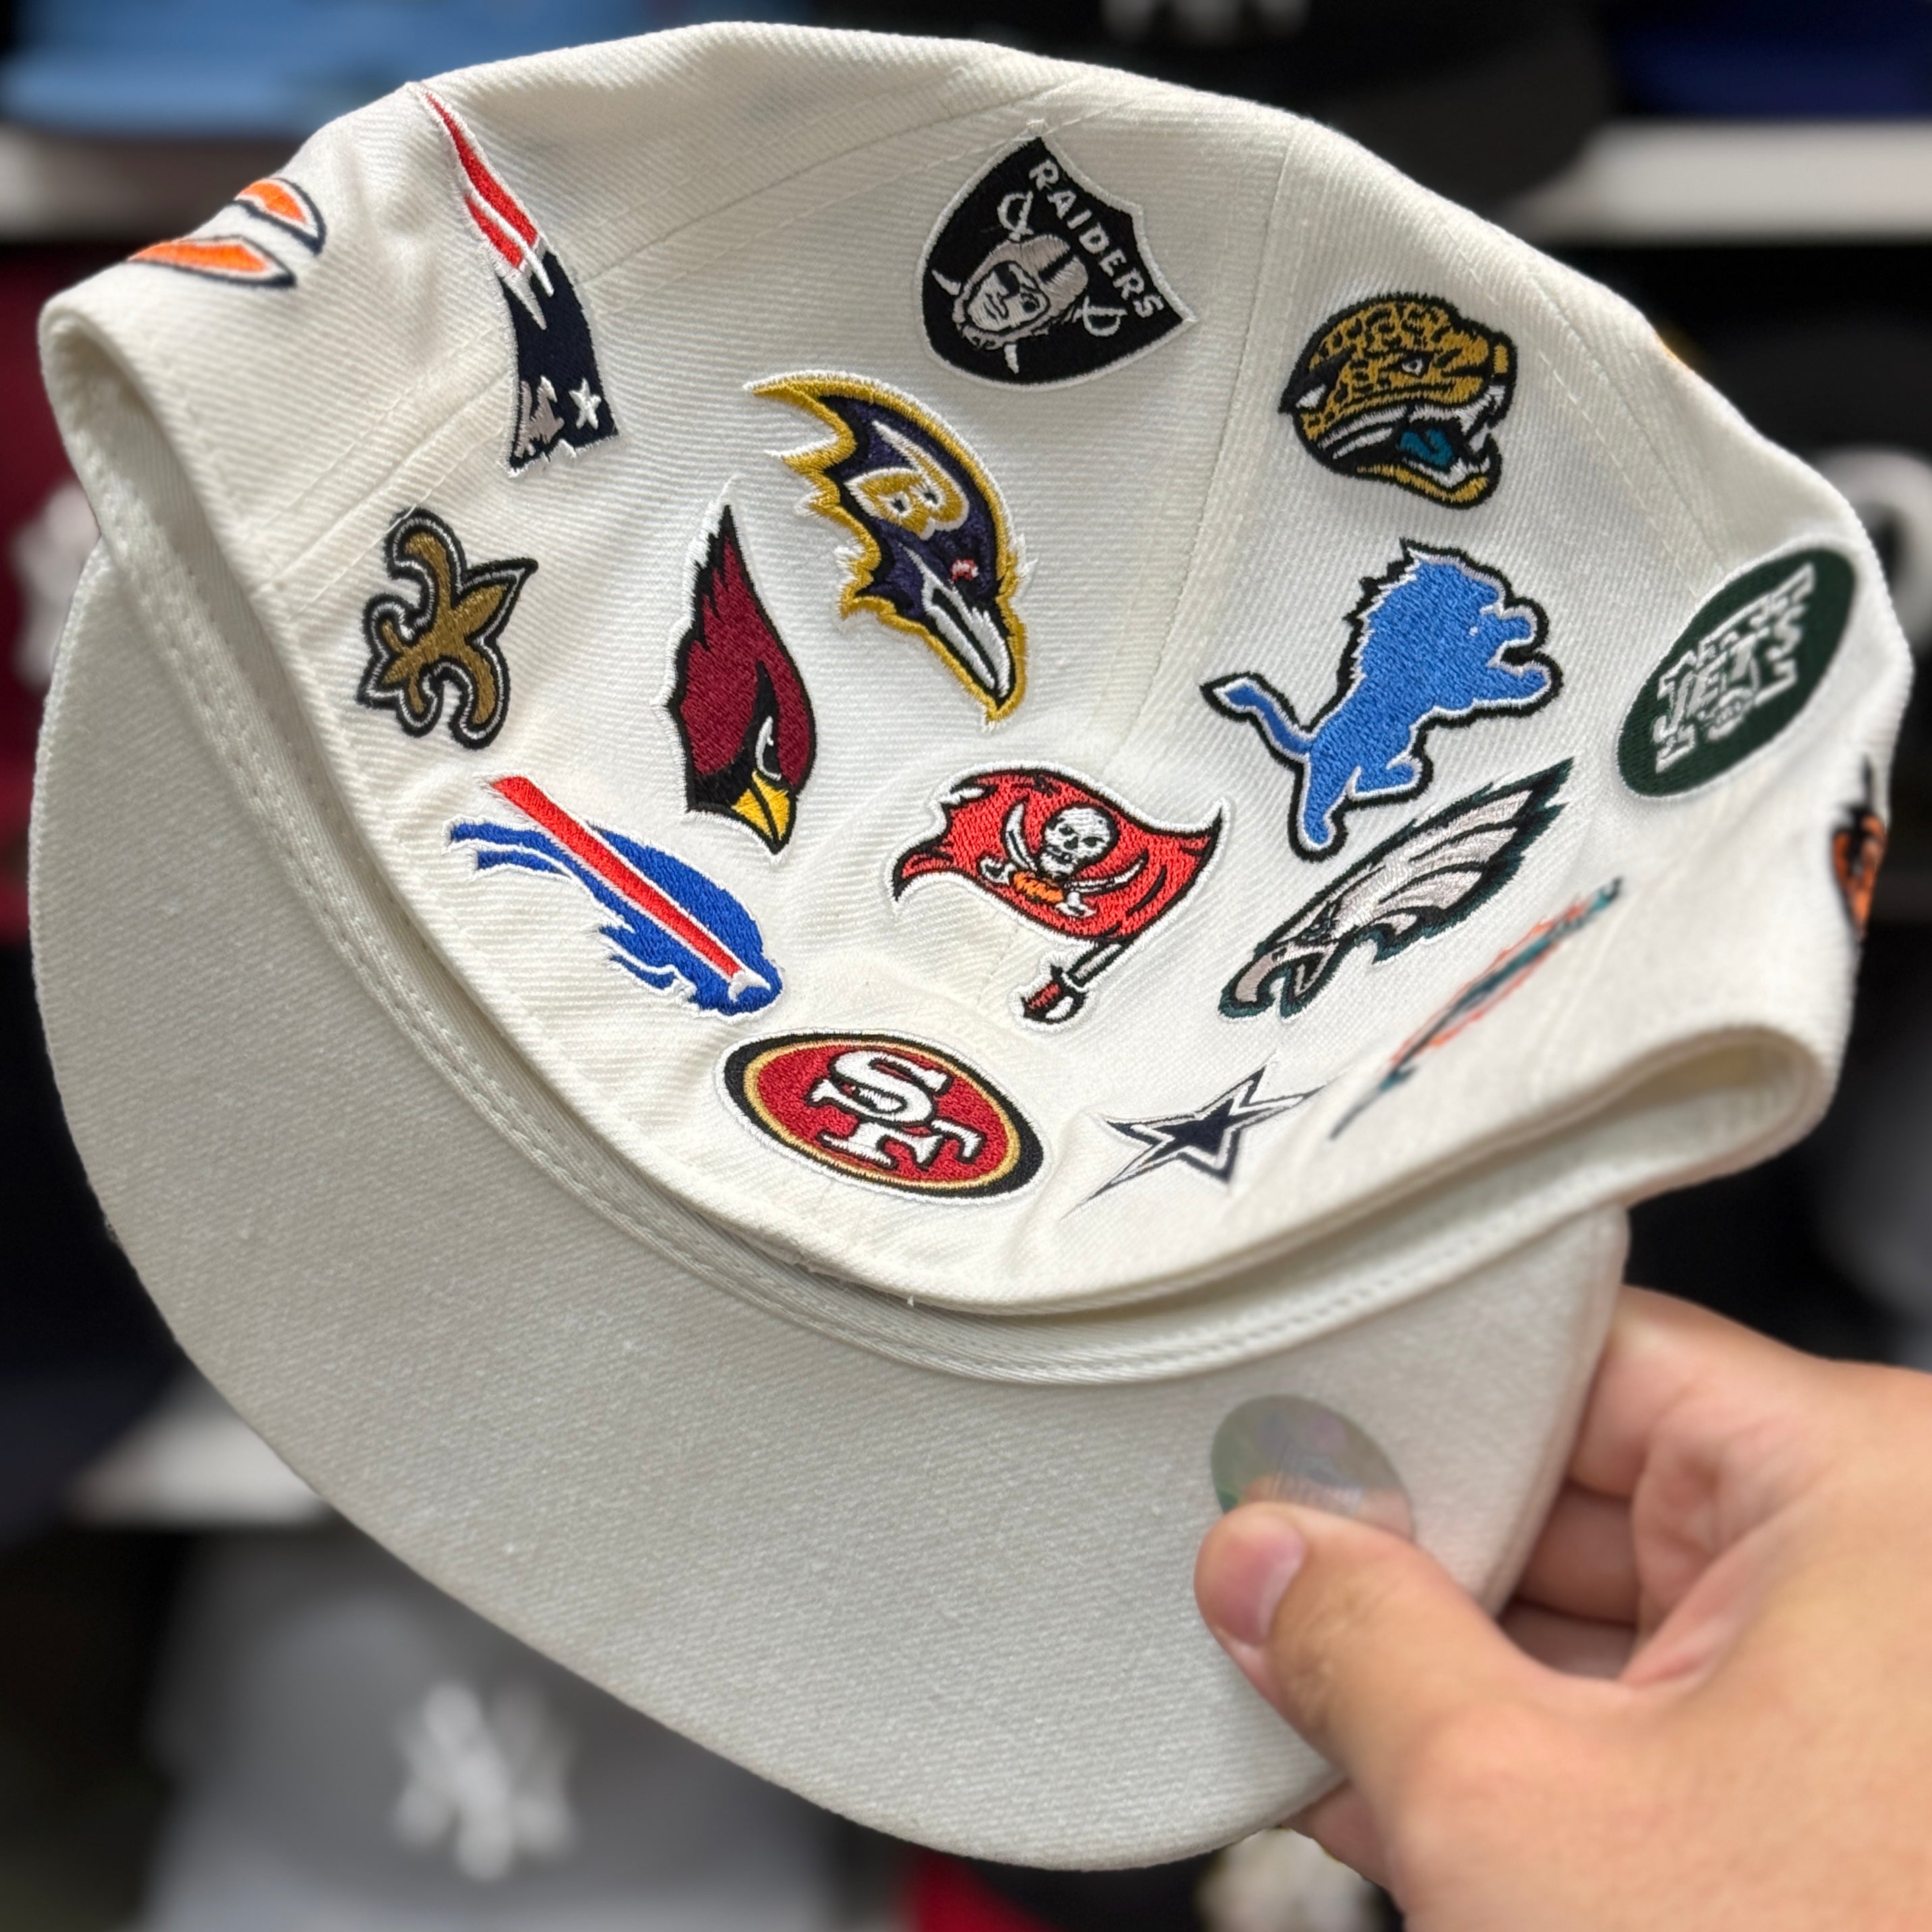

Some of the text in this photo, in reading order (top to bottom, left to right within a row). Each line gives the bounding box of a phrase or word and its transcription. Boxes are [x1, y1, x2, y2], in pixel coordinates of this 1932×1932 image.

[1029, 159, 1164, 319] RAIDERS
[845, 419, 970, 541] B
[1653, 594, 1810, 746] JETS
[808, 1049, 986, 1167] SF
